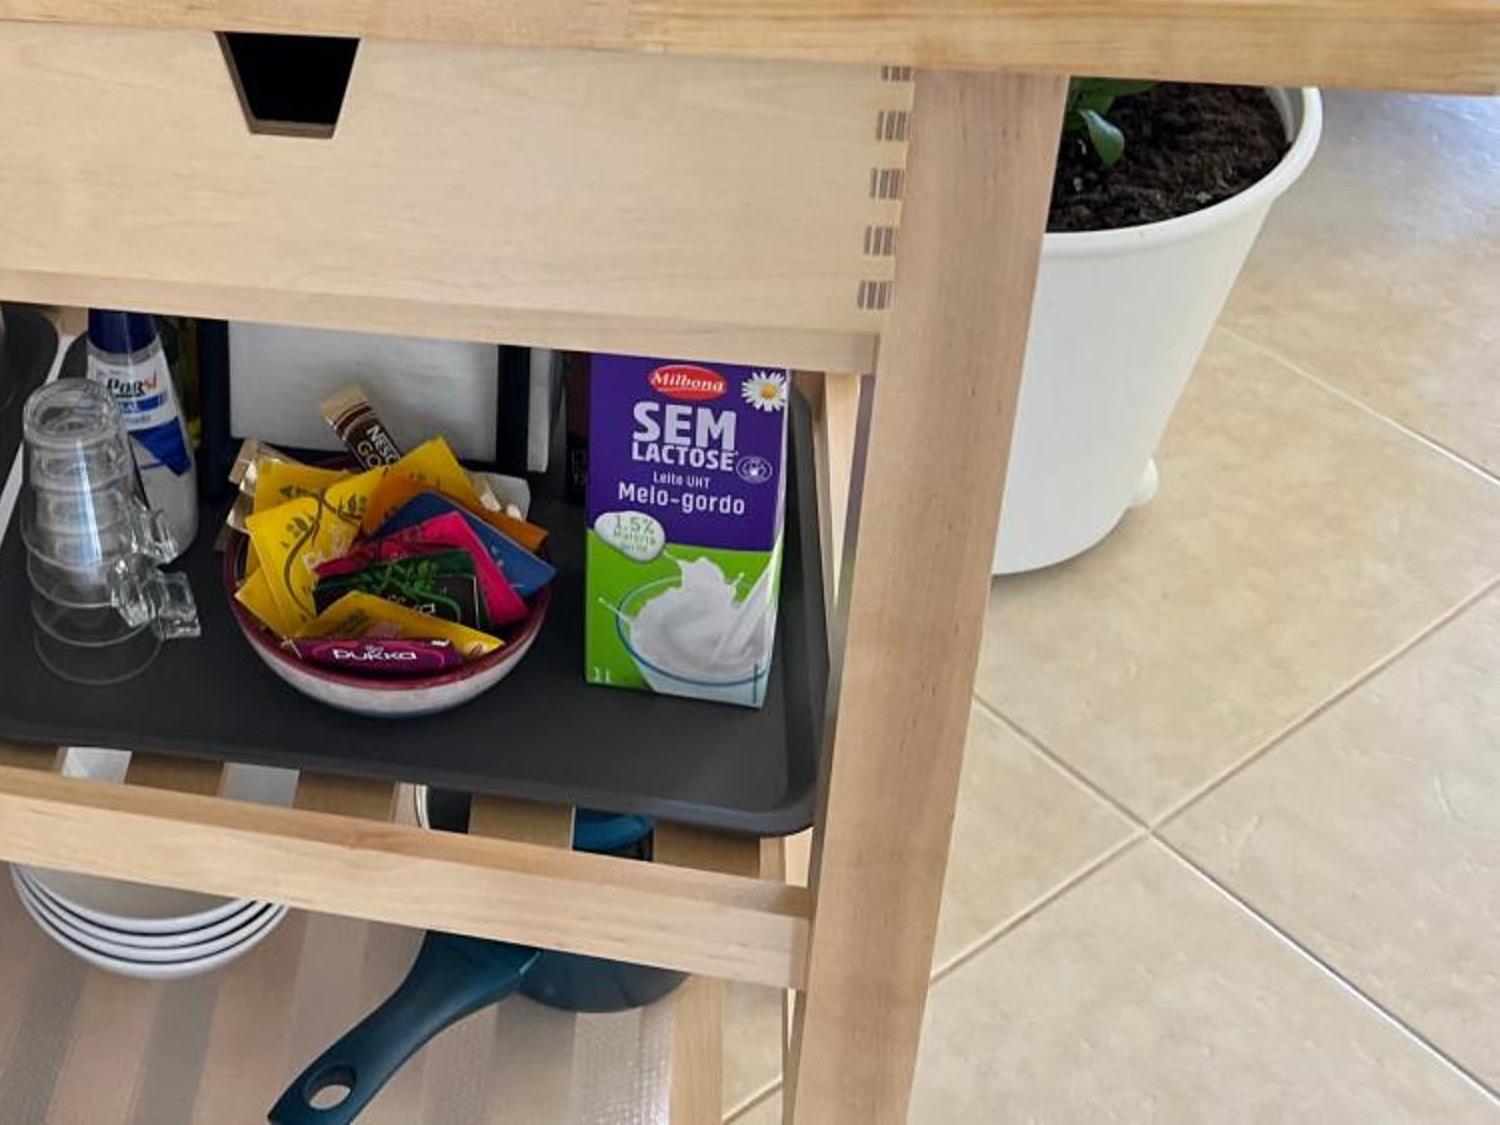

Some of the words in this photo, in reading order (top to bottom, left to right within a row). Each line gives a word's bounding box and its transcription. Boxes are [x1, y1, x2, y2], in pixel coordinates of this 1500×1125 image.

[651, 371, 724, 394] Milbona
[632, 400, 737, 452] SEM
[686, 475, 710, 489] UHT
